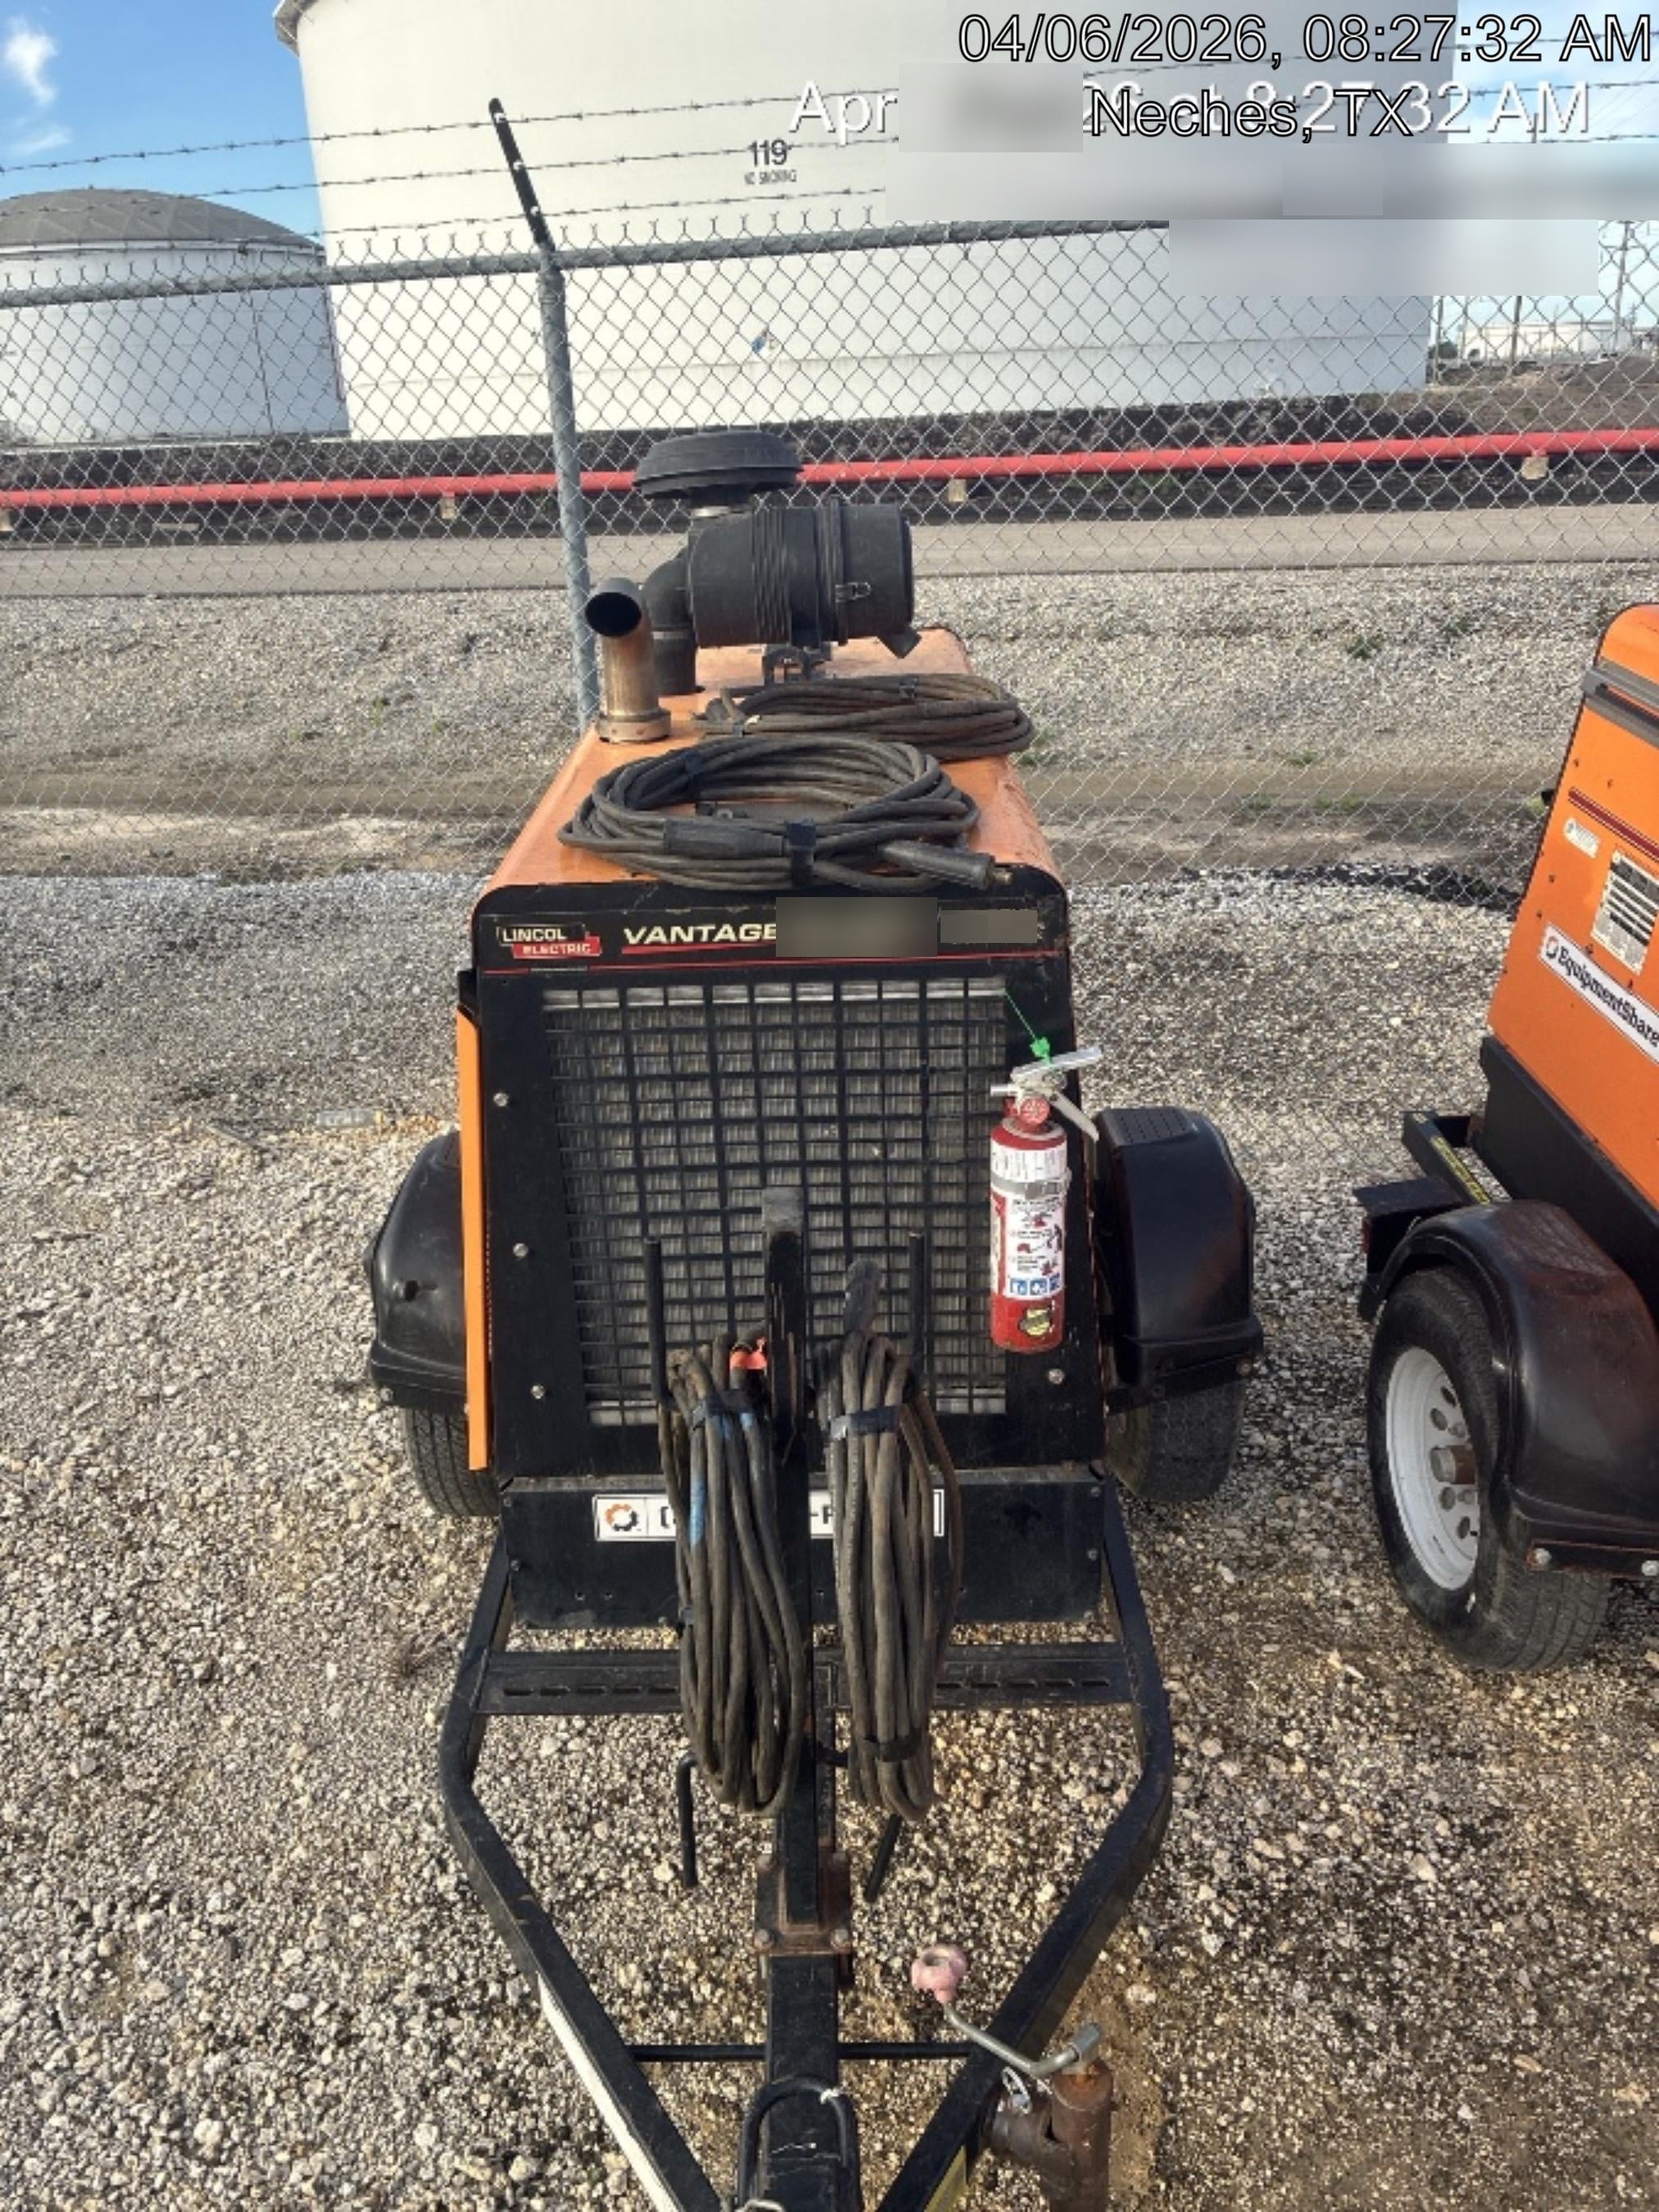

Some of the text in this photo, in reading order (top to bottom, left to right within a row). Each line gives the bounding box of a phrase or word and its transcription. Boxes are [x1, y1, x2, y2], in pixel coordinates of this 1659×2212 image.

[748, 138, 788, 167] 119
[522, 943, 591, 954] ELECTRIC
[1558, 945, 1659, 1048] EquipmentShare
